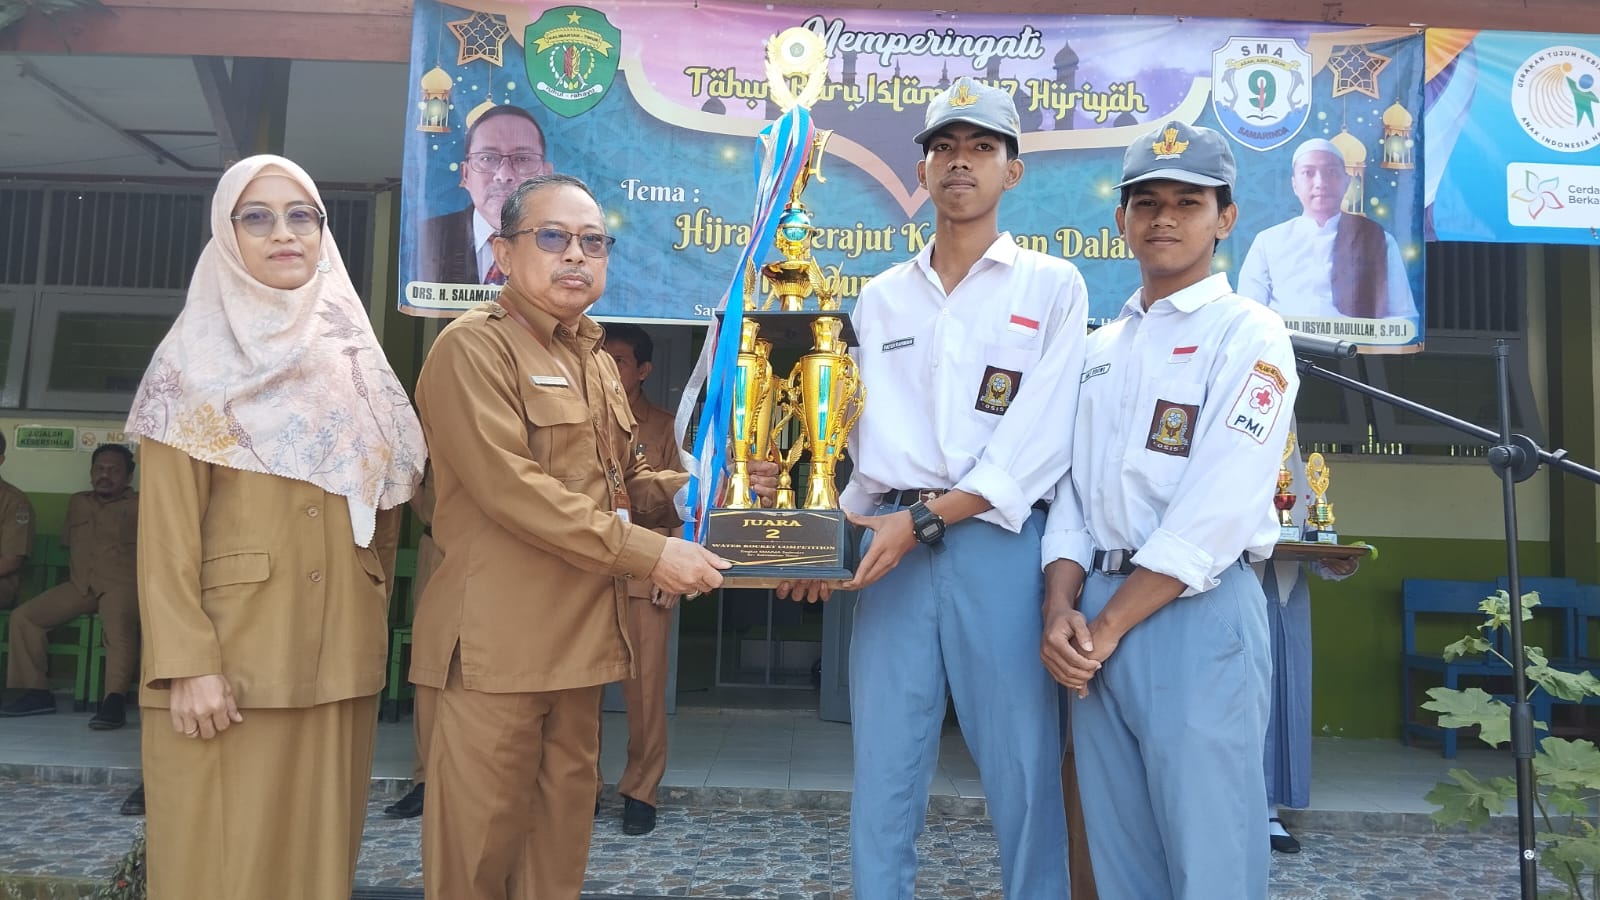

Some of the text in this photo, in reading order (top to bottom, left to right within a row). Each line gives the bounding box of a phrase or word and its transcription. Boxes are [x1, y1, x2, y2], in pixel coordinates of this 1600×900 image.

[802, 16, 1043, 69] Memperingati
[1241, 43, 1283, 58] SMA
[1518, 56, 1545, 88] GERAKAN
[1548, 50, 1577, 58] TUJUH
[1248, 69, 1277, 109] 9
[1237, 126, 1290, 140] SAMARINDA
[1520, 116, 1539, 137] ANAK
[1542, 135, 1590, 148] INDONESIA
[620, 179, 685, 202] Tema
[674, 208, 752, 254] Hijra
[808, 212, 897, 258] erajut
[412, 286, 435, 300] DRS.
[439, 288, 448, 301] H.
[1302, 320, 1331, 334] IRSYAD
[984, 404, 1004, 412] OSIS
[1233, 414, 1265, 438] PMI
[20, 439, 70, 447] KEBERSIHAN
[106, 432, 126, 442] NO
[1156, 442, 1180, 453] OSIS
[742, 519, 803, 528] JUARA
[765, 528, 781, 539] 2
